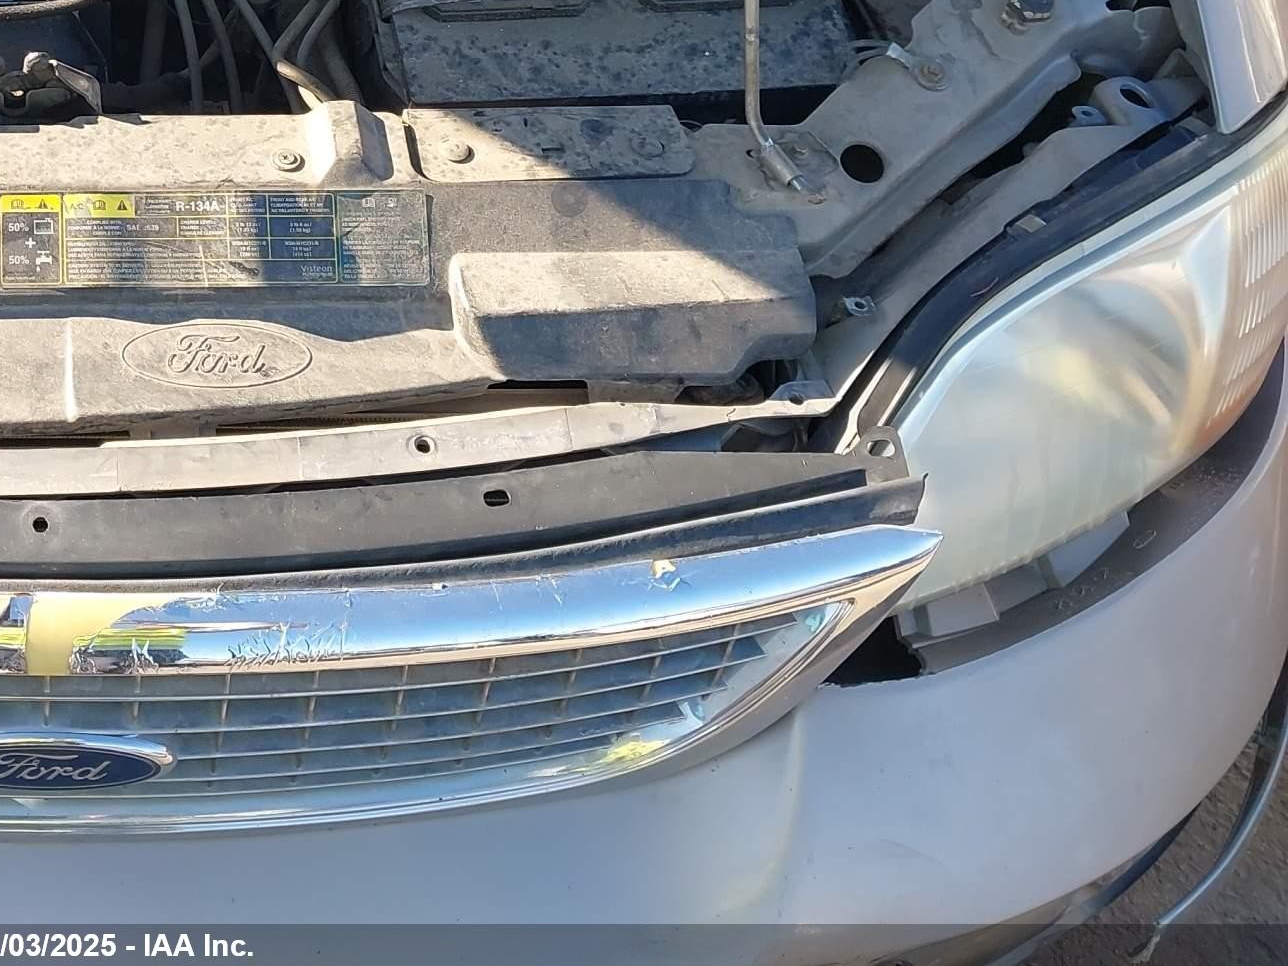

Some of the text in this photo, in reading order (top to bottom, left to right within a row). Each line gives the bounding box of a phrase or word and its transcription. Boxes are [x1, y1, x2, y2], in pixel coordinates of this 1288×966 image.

[175, 200, 220, 212] R-134A
[8, 222, 30, 233] 50%
[8, 255, 30, 265] 50%
[300, 265, 333, 273] Visteon
[167, 333, 267, 375] Ford
